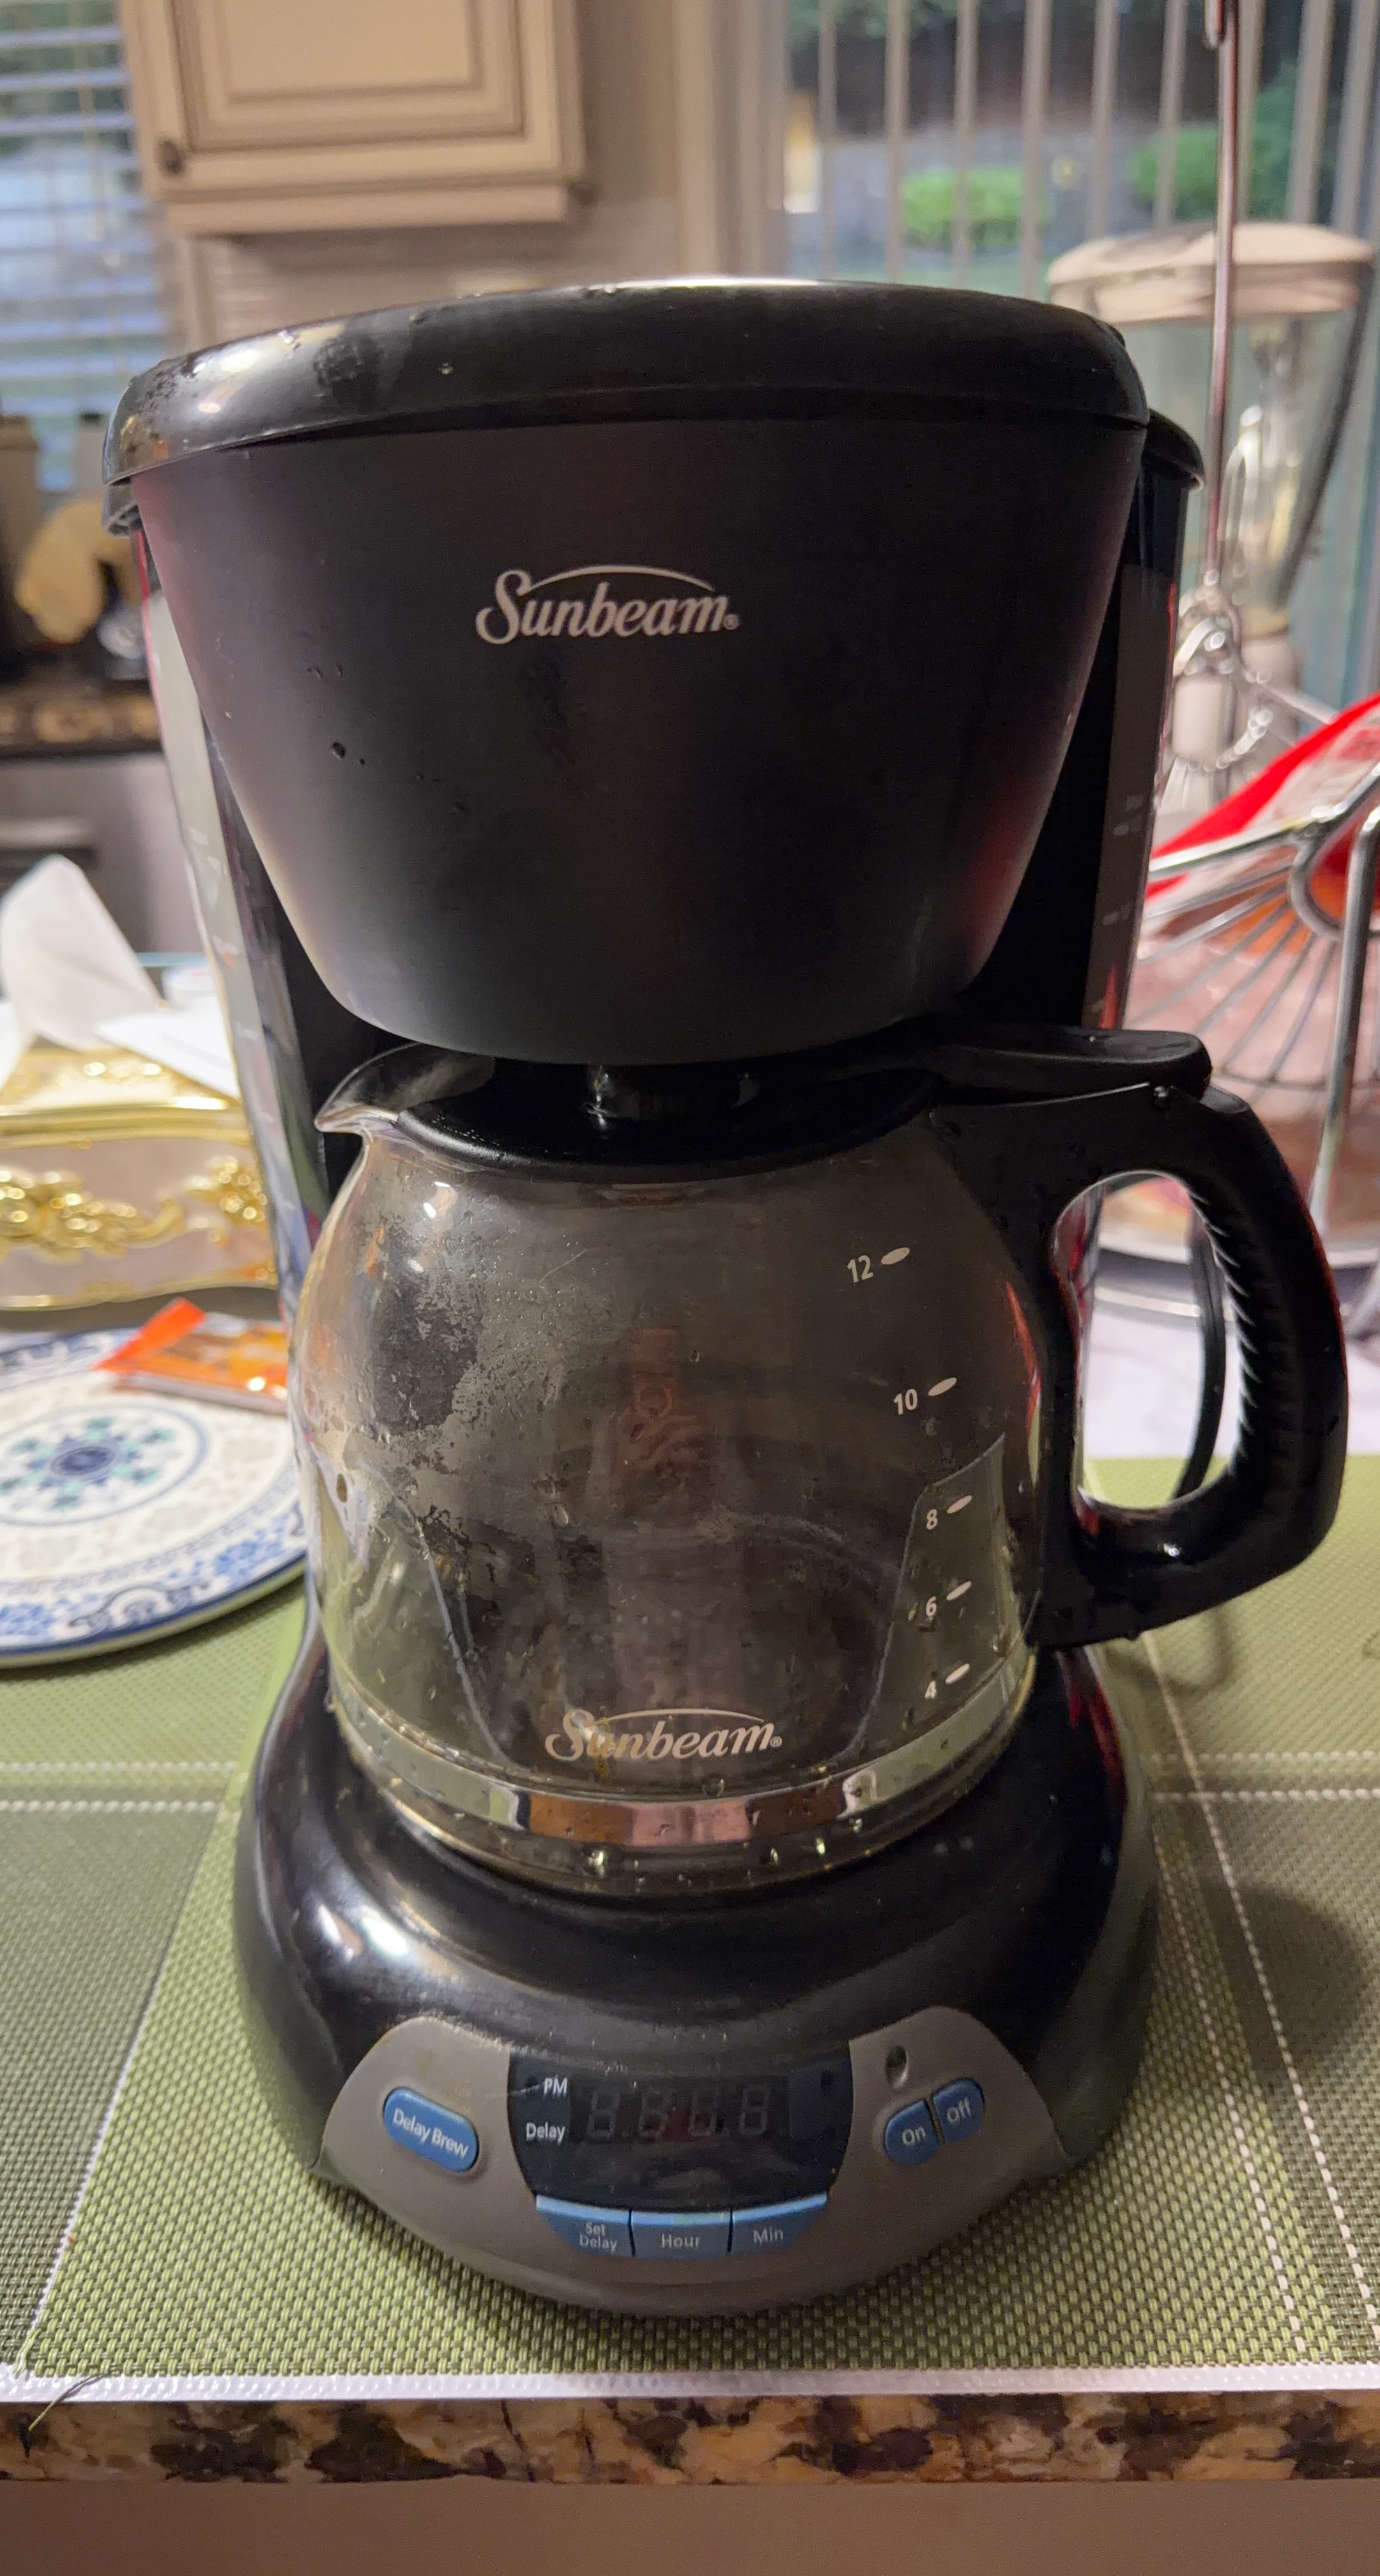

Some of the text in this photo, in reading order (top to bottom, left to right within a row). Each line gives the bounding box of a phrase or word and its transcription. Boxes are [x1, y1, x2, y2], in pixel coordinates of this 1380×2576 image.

[847, 1255, 874, 1284] 12
[894, 1388, 918, 1414] 10
[925, 1508, 939, 1530] 8
[924, 1596, 937, 1617] 6
[924, 1680, 937, 1700] 4
[544, 2077, 568, 2096] PM
[947, 2096, 972, 2124] Off
[392, 2108, 470, 2159] Delay Brew
[526, 2121, 566, 2145] Delay
[901, 2126, 926, 2147] On
[585, 2221, 606, 2236] Set
[753, 2227, 784, 2244] Min
[579, 2234, 618, 2253] Delay
[661, 2234, 701, 2249] Hour
